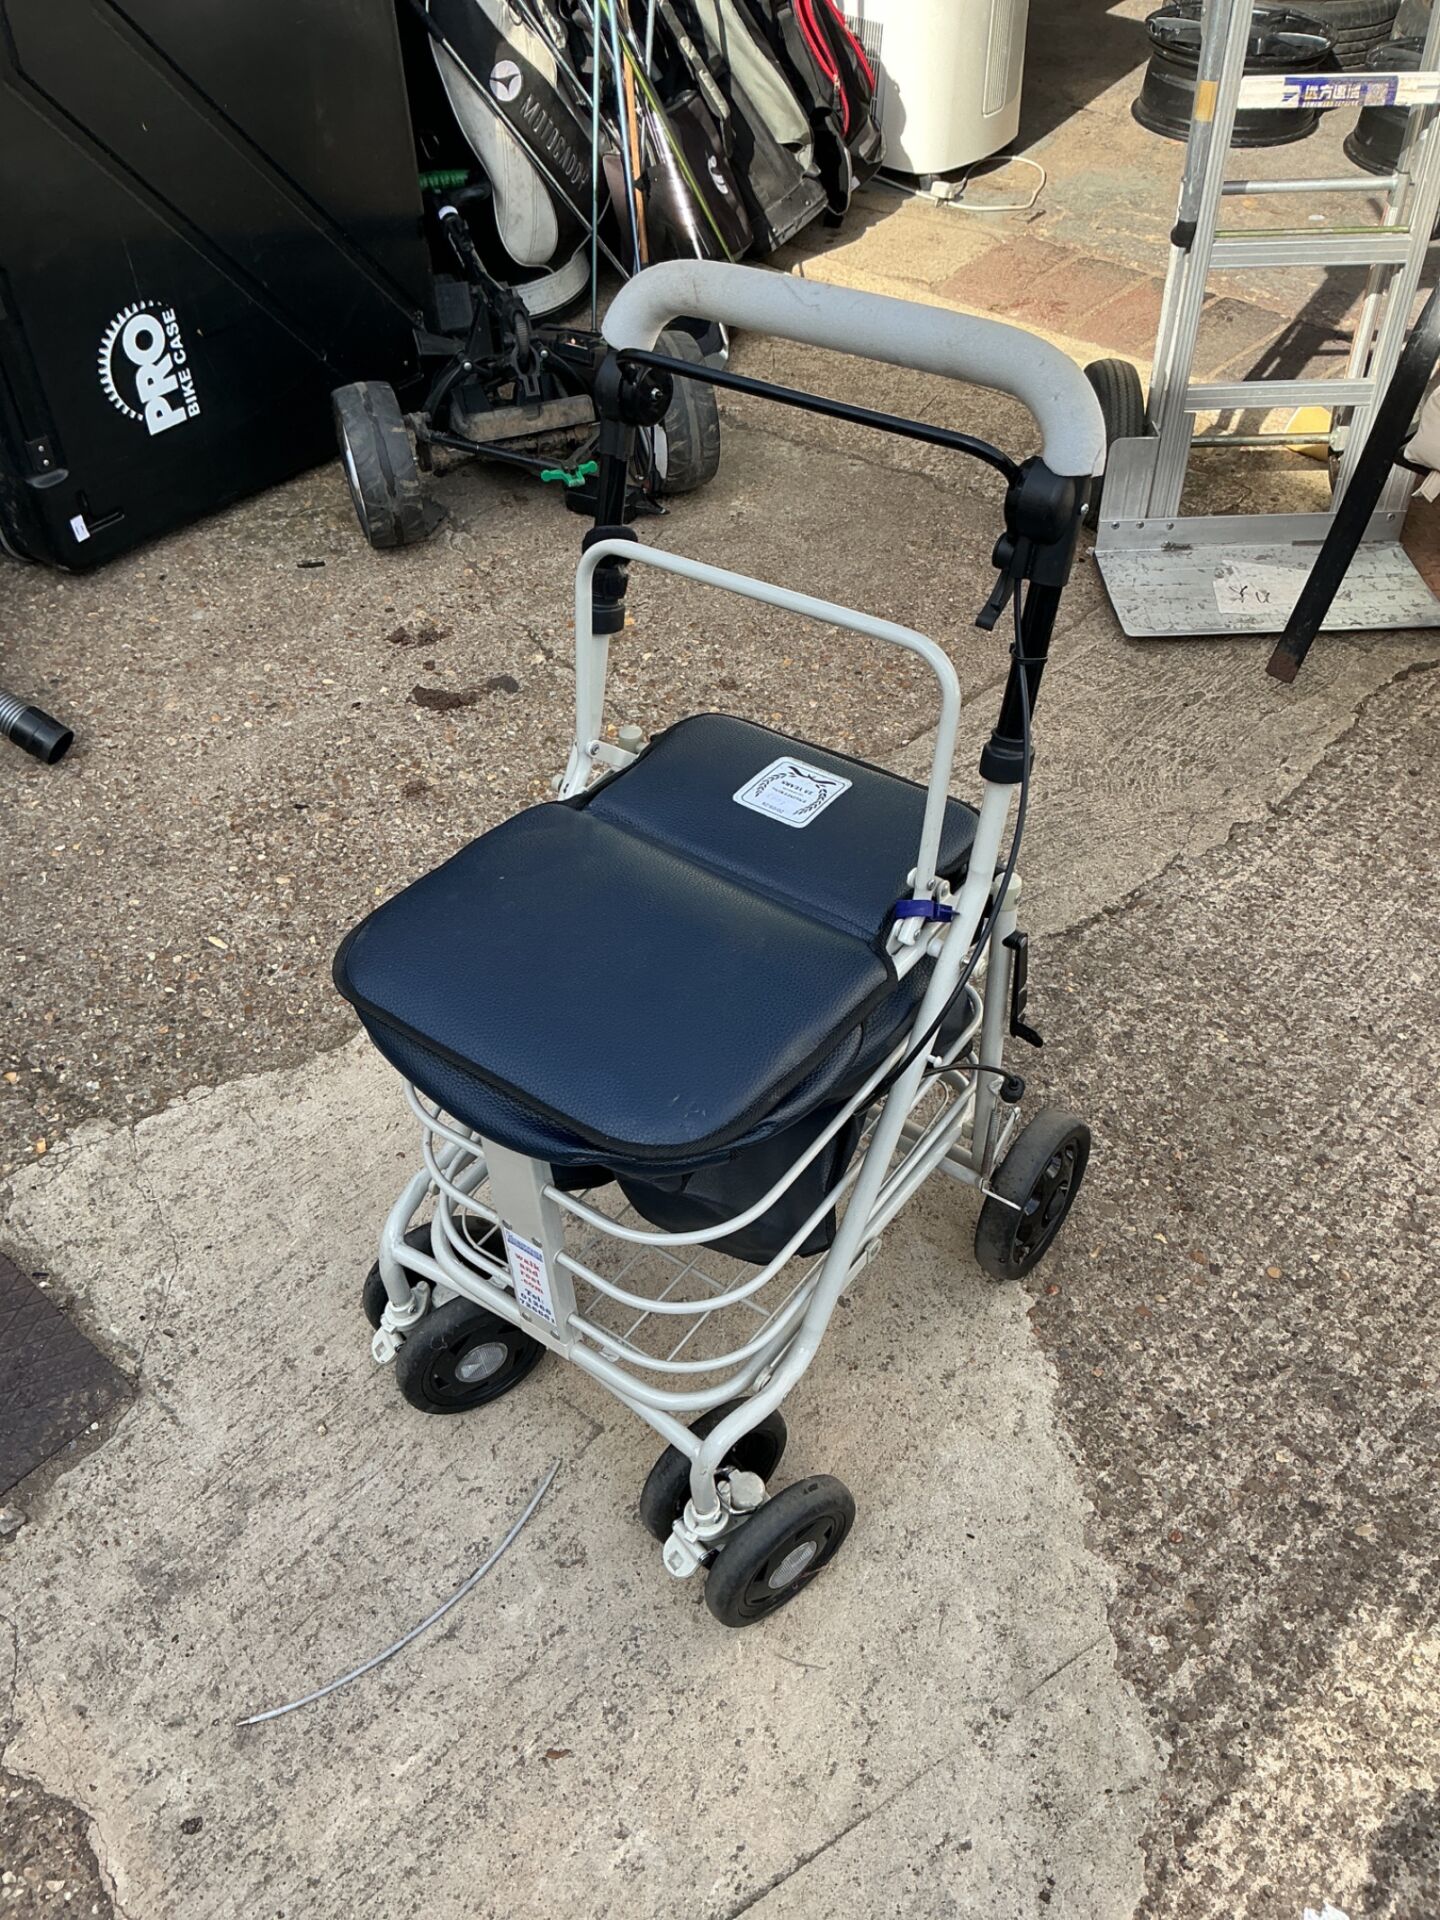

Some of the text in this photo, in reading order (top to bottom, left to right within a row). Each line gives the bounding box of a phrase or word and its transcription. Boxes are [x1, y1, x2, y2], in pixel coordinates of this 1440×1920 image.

[520, 93, 589, 191] MOTOCADDY
[122, 313, 188, 436] PRO
[161, 308, 201, 417] BIKE CASE
